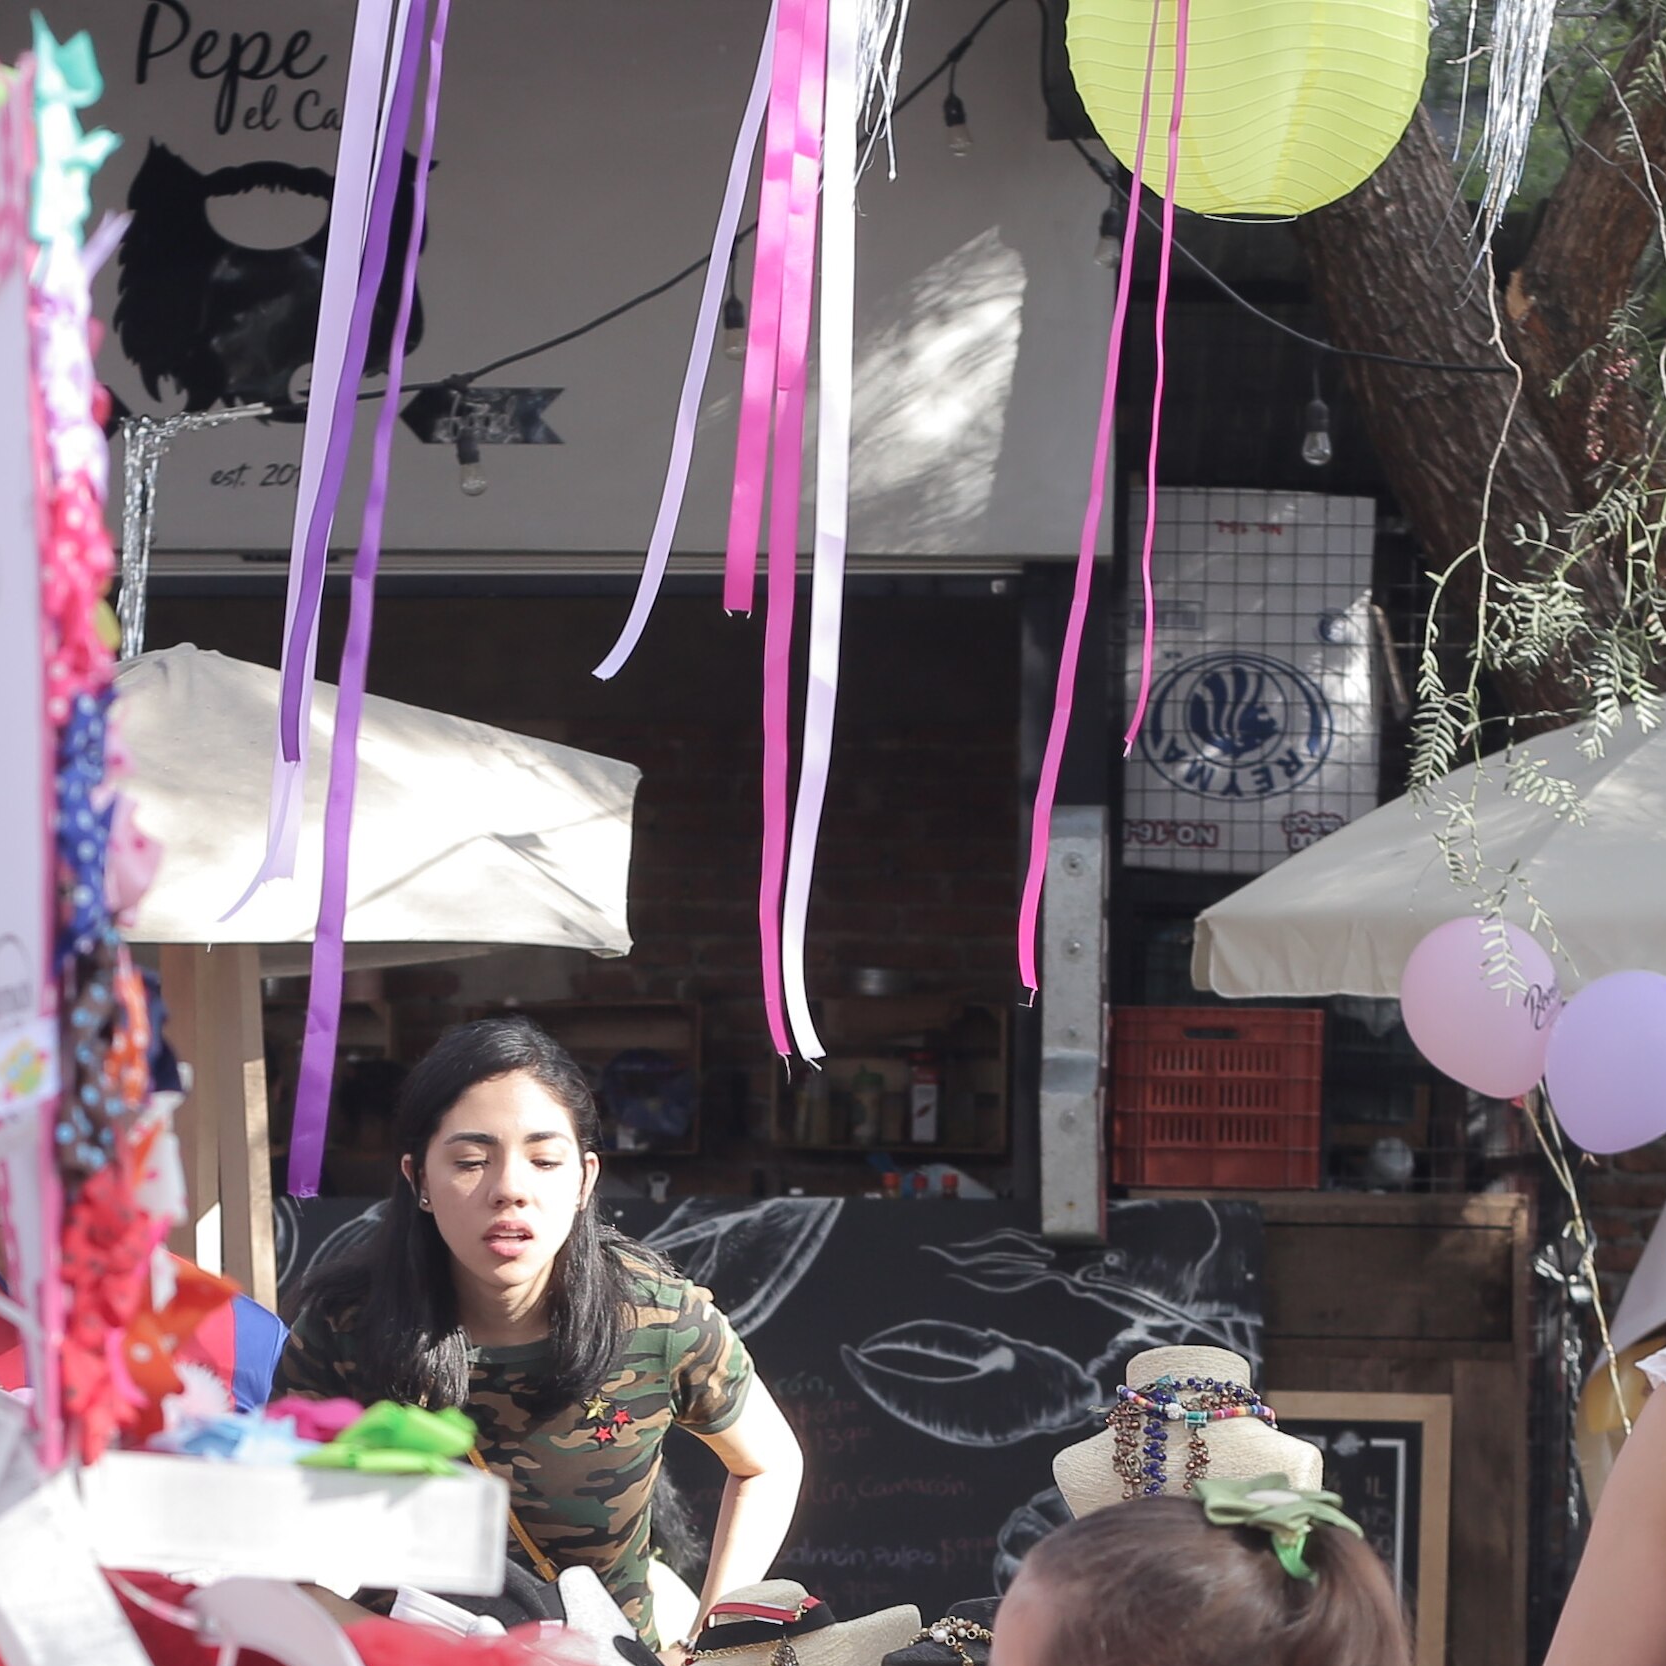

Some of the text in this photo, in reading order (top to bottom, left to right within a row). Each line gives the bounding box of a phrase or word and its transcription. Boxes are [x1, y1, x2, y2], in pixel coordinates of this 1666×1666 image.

[135, 0, 326, 136] Pepe
[244, 84, 281, 131] el
[210, 462, 302, 488] est. 201
[1162, 736, 1305, 797] REYMA
